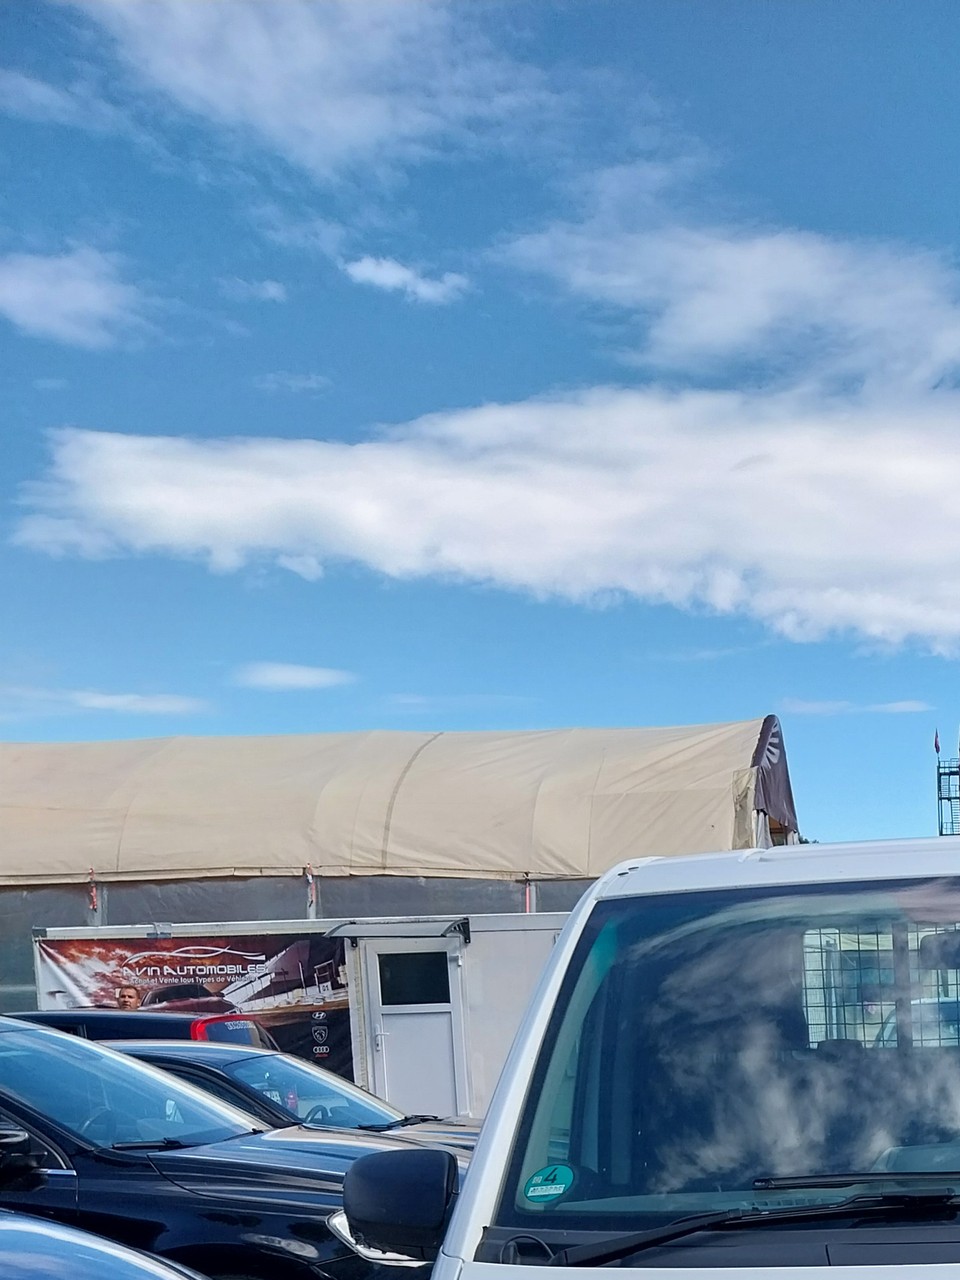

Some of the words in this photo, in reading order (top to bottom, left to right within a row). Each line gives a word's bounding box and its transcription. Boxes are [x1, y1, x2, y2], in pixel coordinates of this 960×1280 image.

[163, 964, 266, 975] AUTOMOBILES
[195, 976, 215, 984] Types
[543, 1167, 559, 1184] 4
